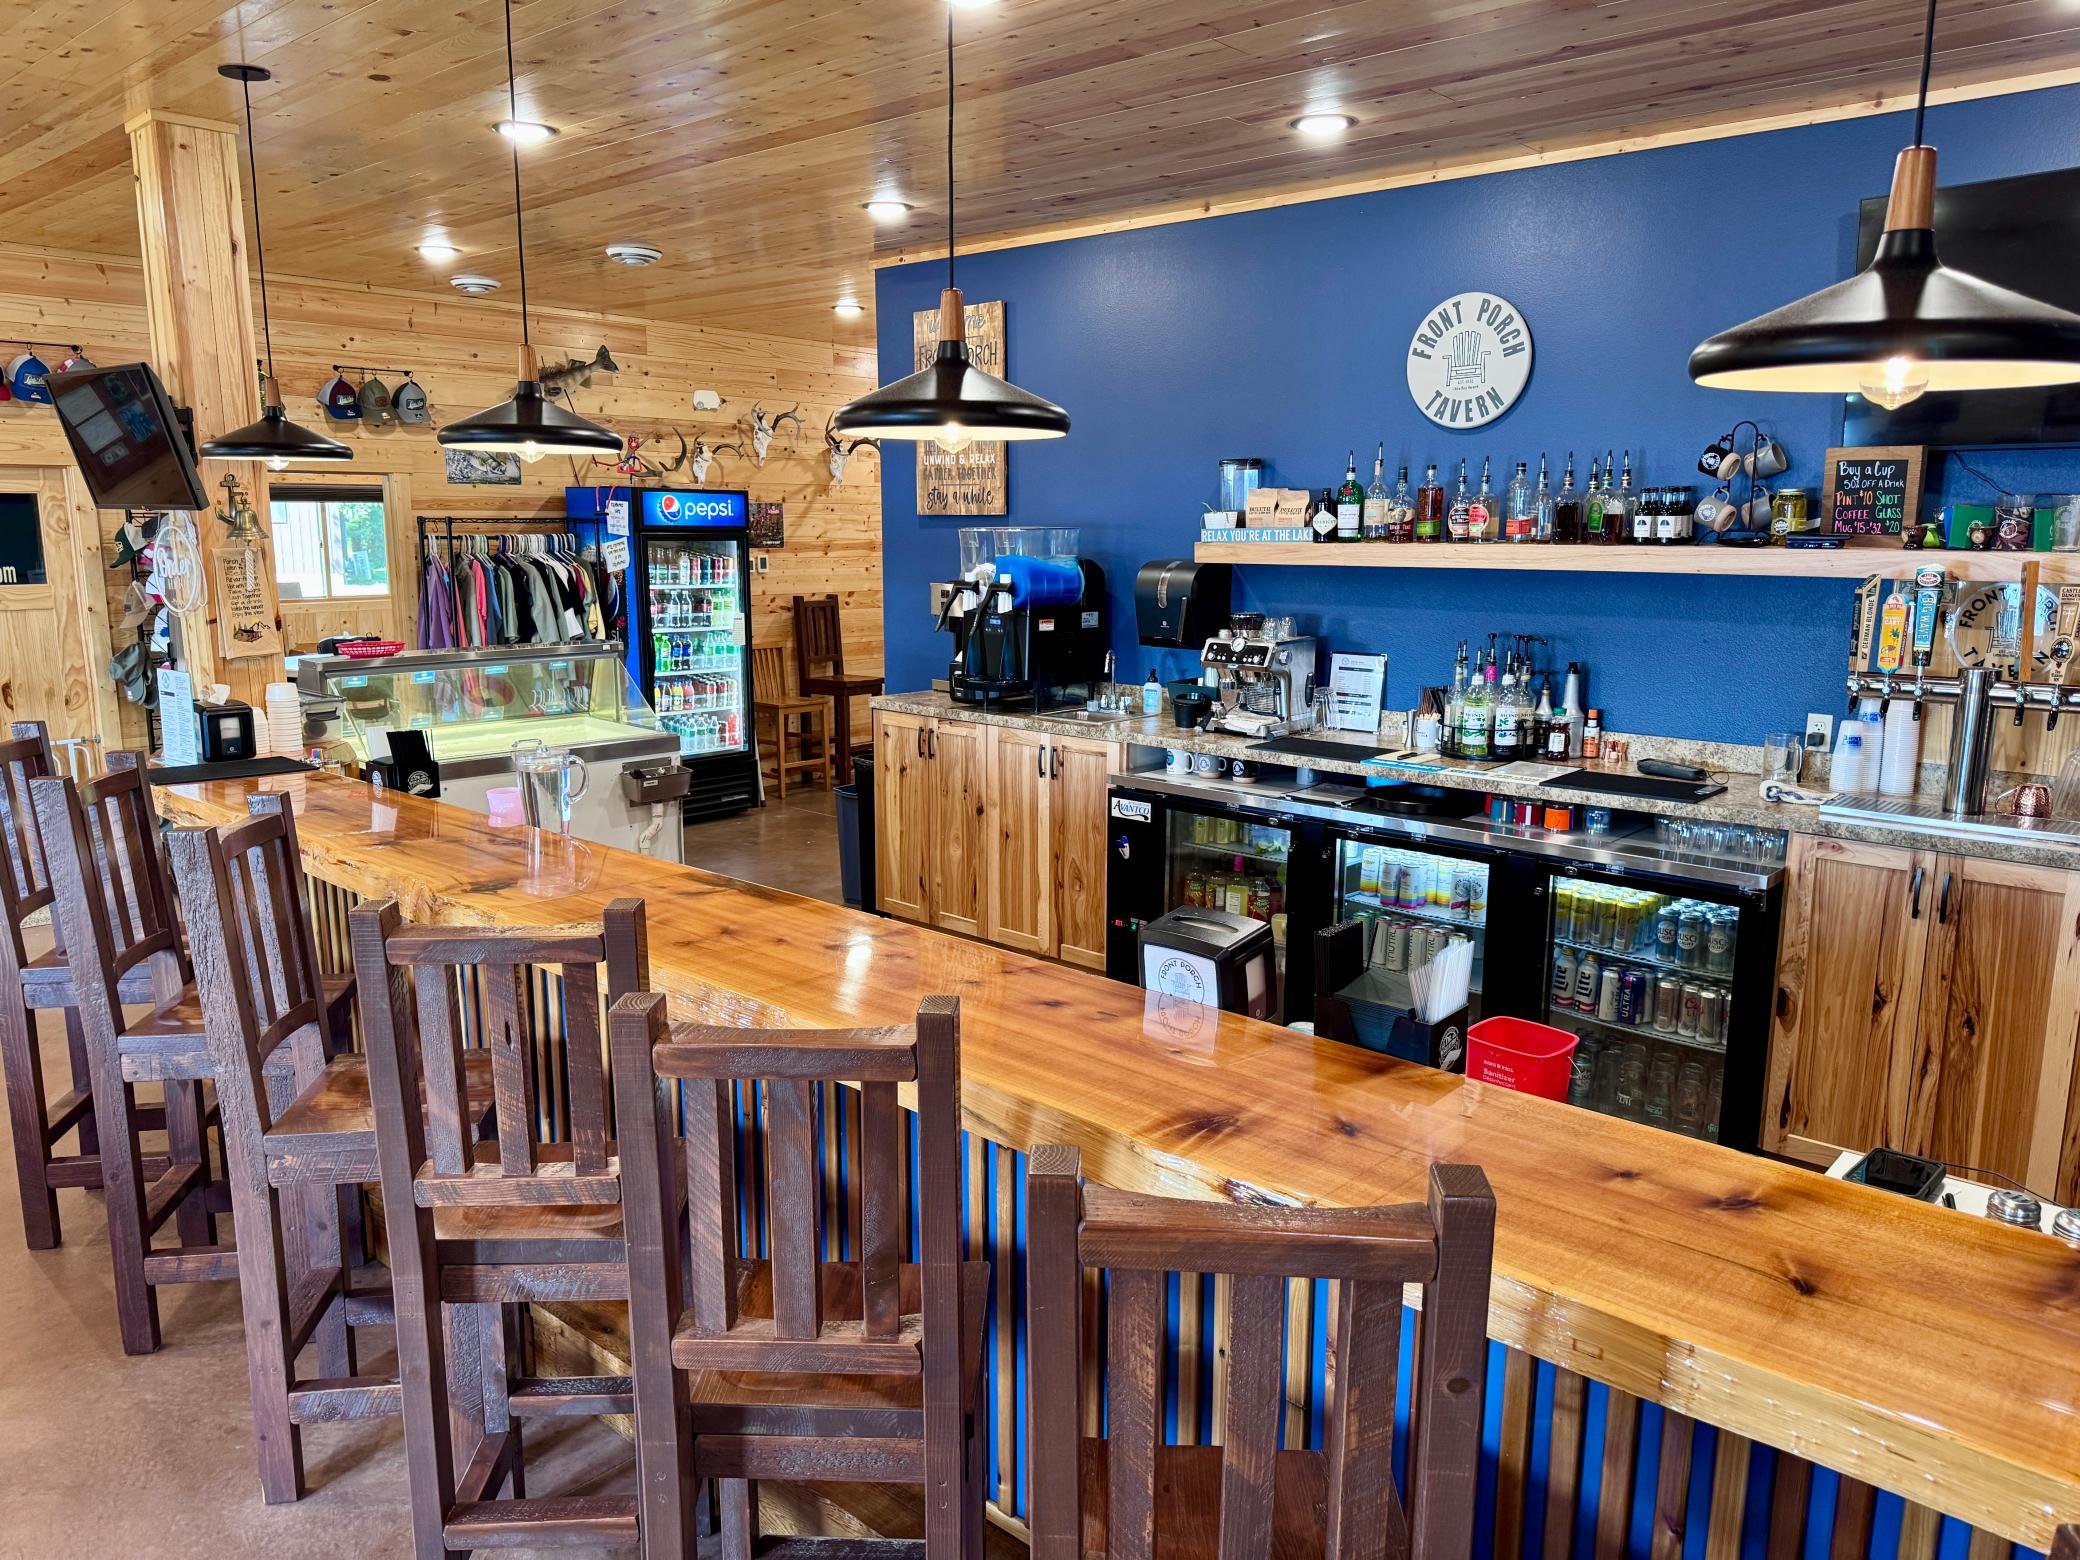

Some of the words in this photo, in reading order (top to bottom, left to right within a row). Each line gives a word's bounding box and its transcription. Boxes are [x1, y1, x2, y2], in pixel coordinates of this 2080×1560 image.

[1412, 300, 1461, 360] FRONT
[1477, 298, 1525, 358] PORCH
[1425, 387, 1505, 422] TAVERN
[923, 454, 956, 465] UNWIND
[959, 455, 965, 465] &
[969, 453, 996, 464] RELAX
[956, 466, 997, 481] TOGETHER
[1839, 461, 1861, 480] Buy
[1865, 466, 1872, 475] a
[1874, 461, 1896, 479] Cup
[1861, 479, 1877, 489] OFF
[1878, 479, 1884, 488] A
[927, 485, 948, 511] stay
[963, 487, 994, 505] while
[1875, 491, 1901, 505] SHOT
[1836, 507, 1870, 520] COFFEE
[1875, 506, 1902, 519] GLASS
[1202, 529, 1227, 542] RELAX
[1230, 529, 1260, 541] YOU'RE
[1262, 530, 1272, 541] AT
[1273, 529, 1291, 541] THE
[1866, 599, 1875, 623] BLONDE
[1920, 596, 1935, 613] BIG
[1959, 587, 2006, 628] FRONT
[1862, 623, 1871, 649] GERMAN
[1917, 615, 1931, 639] WAVE
[1113, 800, 1150, 817] AVANTCO
[1160, 960, 1178, 980] FRONT
[1180, 961, 1202, 989] PORCH
[1553, 965, 1569, 992] Lite
[1576, 971, 1592, 998] Lite
[1621, 988, 1632, 1018] ULTRA
[1483, 1068, 1516, 1083] Sanitizer
